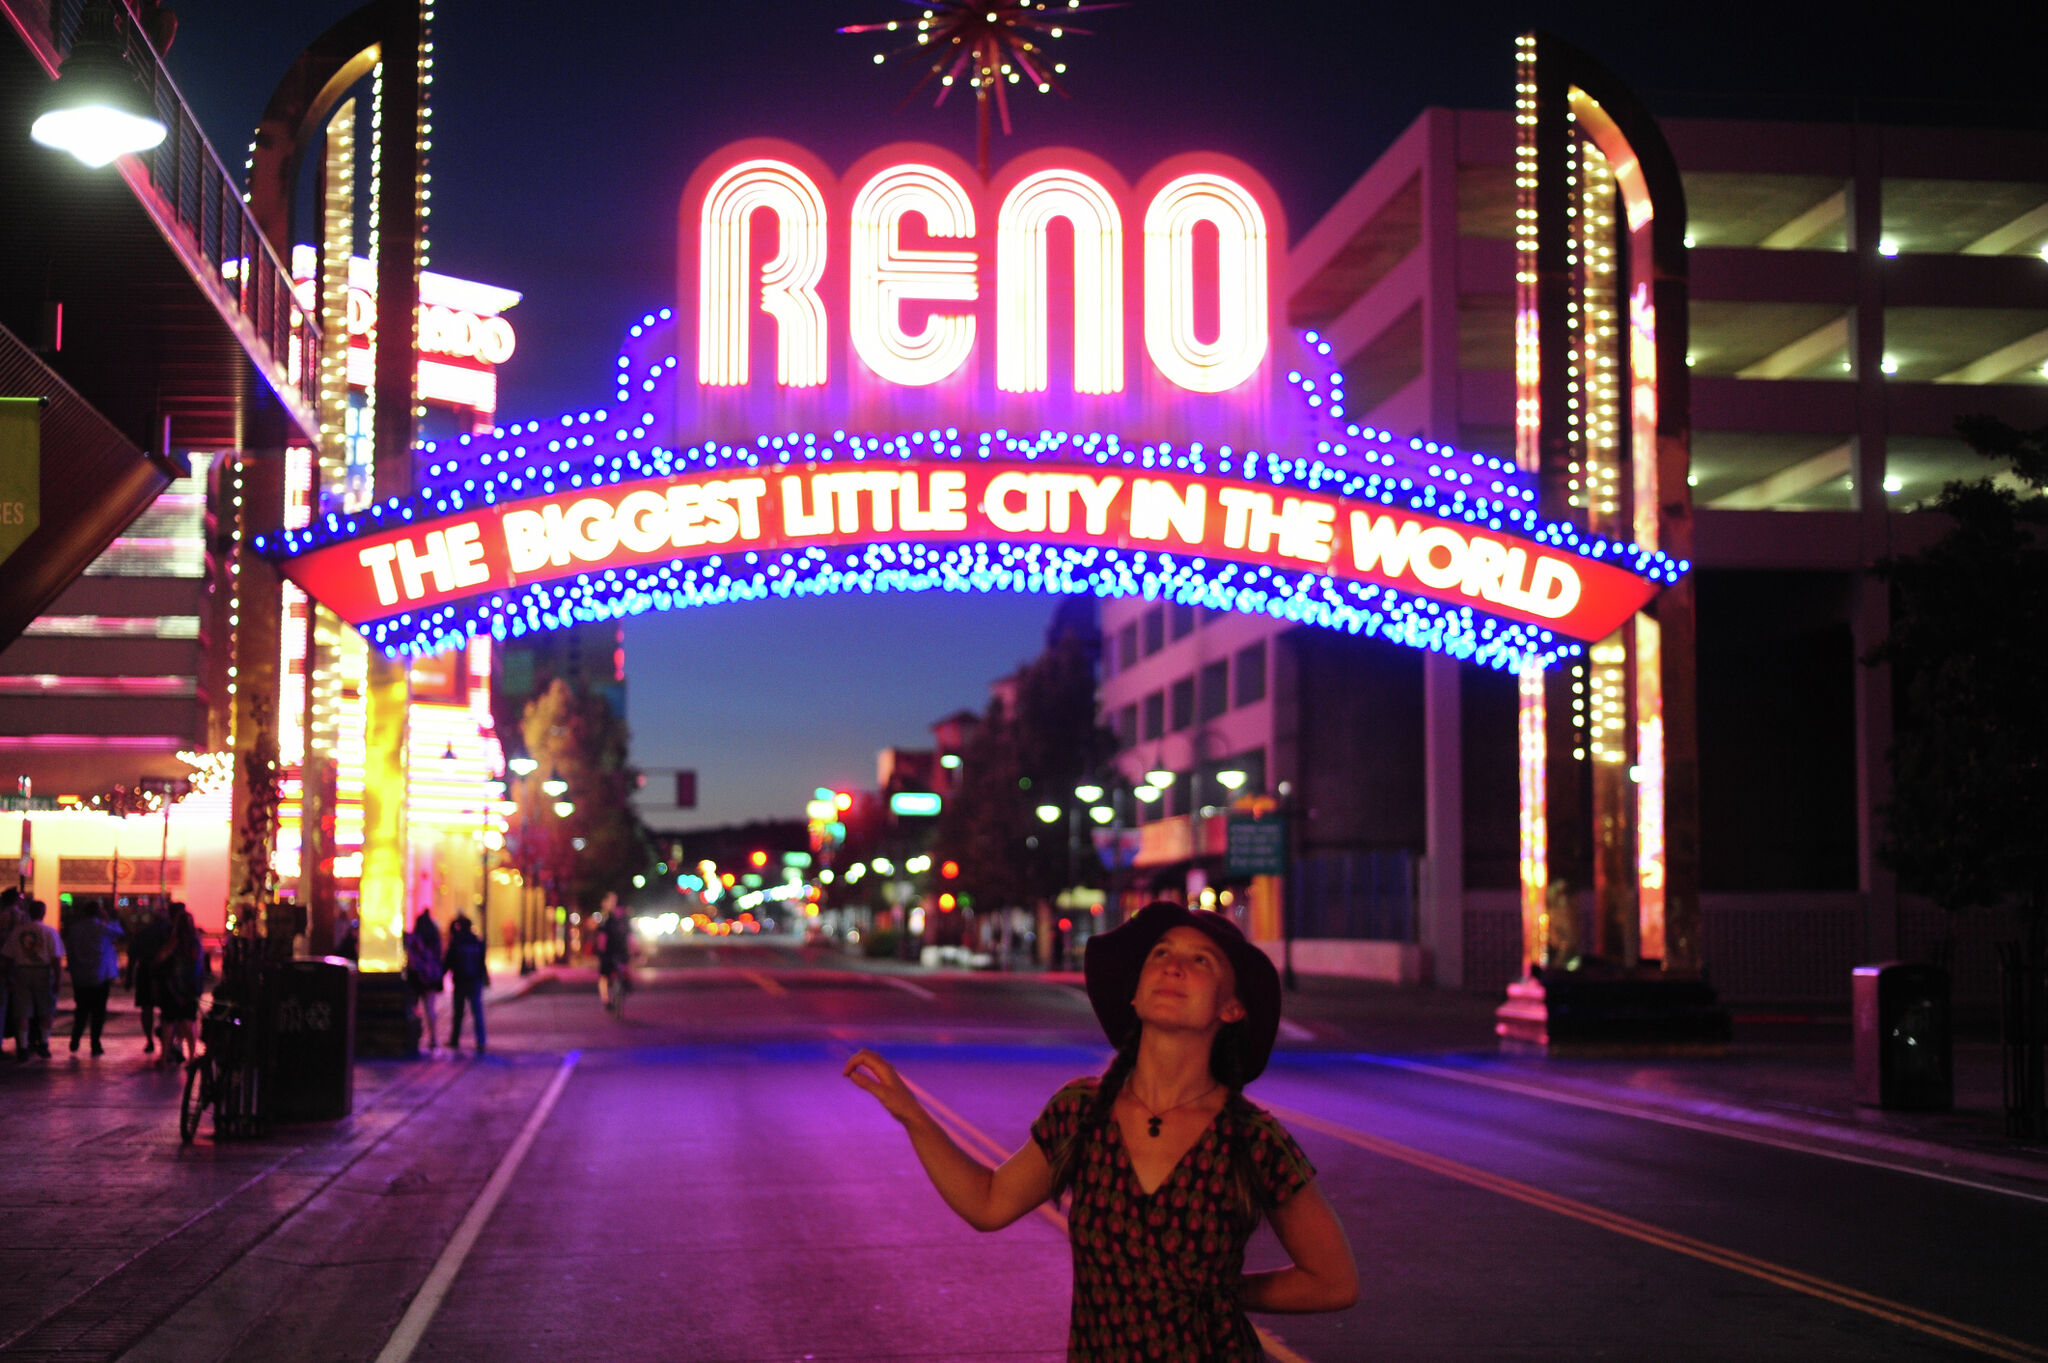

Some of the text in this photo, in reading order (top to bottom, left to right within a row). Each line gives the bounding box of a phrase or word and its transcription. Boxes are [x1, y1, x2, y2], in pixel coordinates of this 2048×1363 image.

[697, 159, 1268, 395] RENO
[0, 502, 25, 525] ES
[358, 471, 1581, 619] THE BIGGEST LITTLE CITY IN THE WORLD
